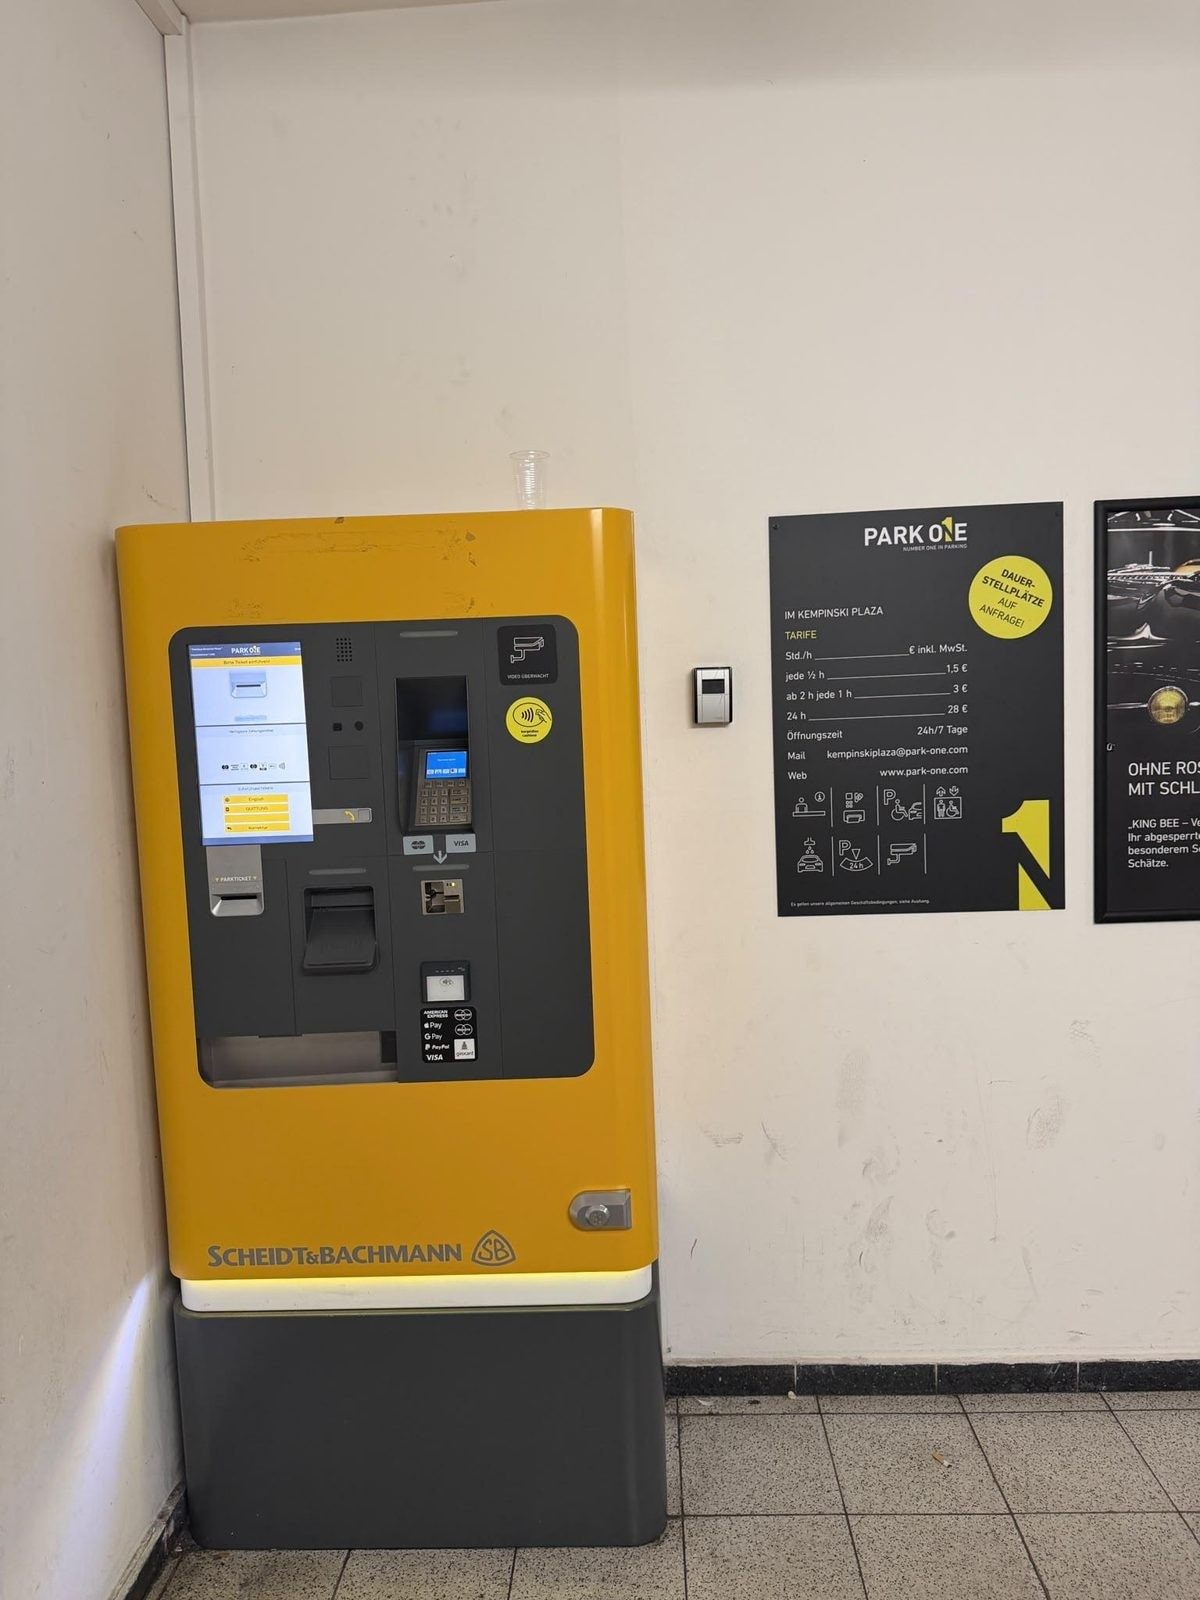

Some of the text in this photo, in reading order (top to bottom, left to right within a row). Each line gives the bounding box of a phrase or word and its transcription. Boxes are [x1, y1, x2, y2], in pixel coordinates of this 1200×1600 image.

[864, 524, 924, 547] PARK
[1000, 568, 1036, 589] DAUER-
[981, 575, 1046, 608] STELLPLÄTZE
[997, 596, 1018, 610] AUF
[784, 606, 884, 620] IM KEMPINSKI PLAZA
[979, 604, 1025, 629] ANFRAGE!
[785, 630, 817, 640] TARIFE
[908, 643, 968, 654] € inkl. MwSt.
[785, 651, 812, 661] Std./h
[946, 663, 968, 675] 1,5 €
[785, 671, 805, 682] jede
[818, 670, 825, 679] h
[953, 684, 968, 693] 3 €
[786, 689, 852, 702] ab 2 h jede 1 h
[947, 704, 968, 714] 28 €
[786, 711, 807, 721] 24 h
[786, 729, 843, 741] Öffnungszeit
[917, 725, 969, 736] 24h/7 Tage
[787, 745, 969, 760] Mail kempinskiplaza@park-one.com
[788, 765, 969, 780] Web www.park-one.com
[1128, 762, 1171, 776] OHNE
[1128, 781, 1200, 796] MIT SCHL
[1160, 818, 1180, 828] BEE
[453, 839, 469, 847] VISA
[1128, 833, 1142, 842] Ihr
[1128, 845, 1189, 855] besonderem
[1128, 858, 1169, 868] Schätze.
